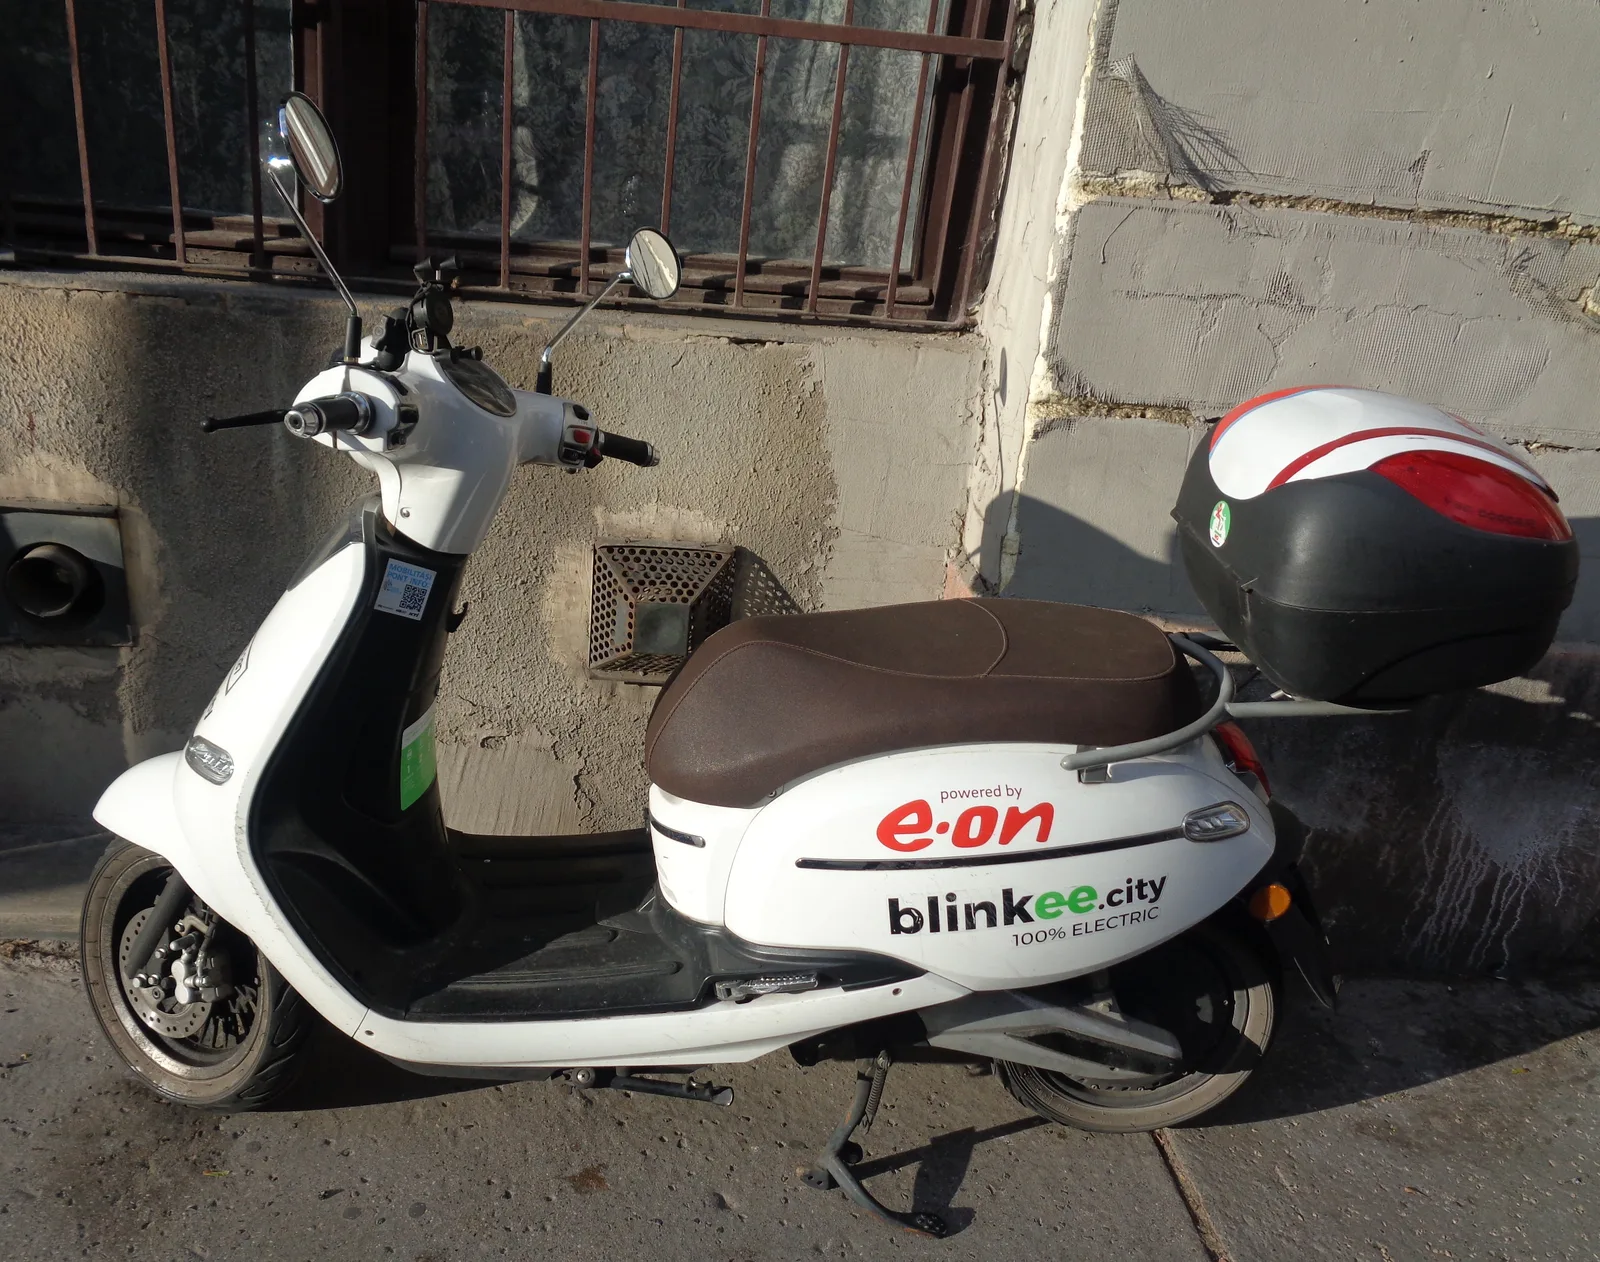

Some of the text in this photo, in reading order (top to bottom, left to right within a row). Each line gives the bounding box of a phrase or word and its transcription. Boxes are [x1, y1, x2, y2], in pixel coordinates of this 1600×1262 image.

[387, 571, 408, 582] PONT
[940, 784, 1022, 803] powered by
[888, 875, 1167, 935] blinkee.city
[1012, 906, 1159, 947] 100% ELECTRIC
